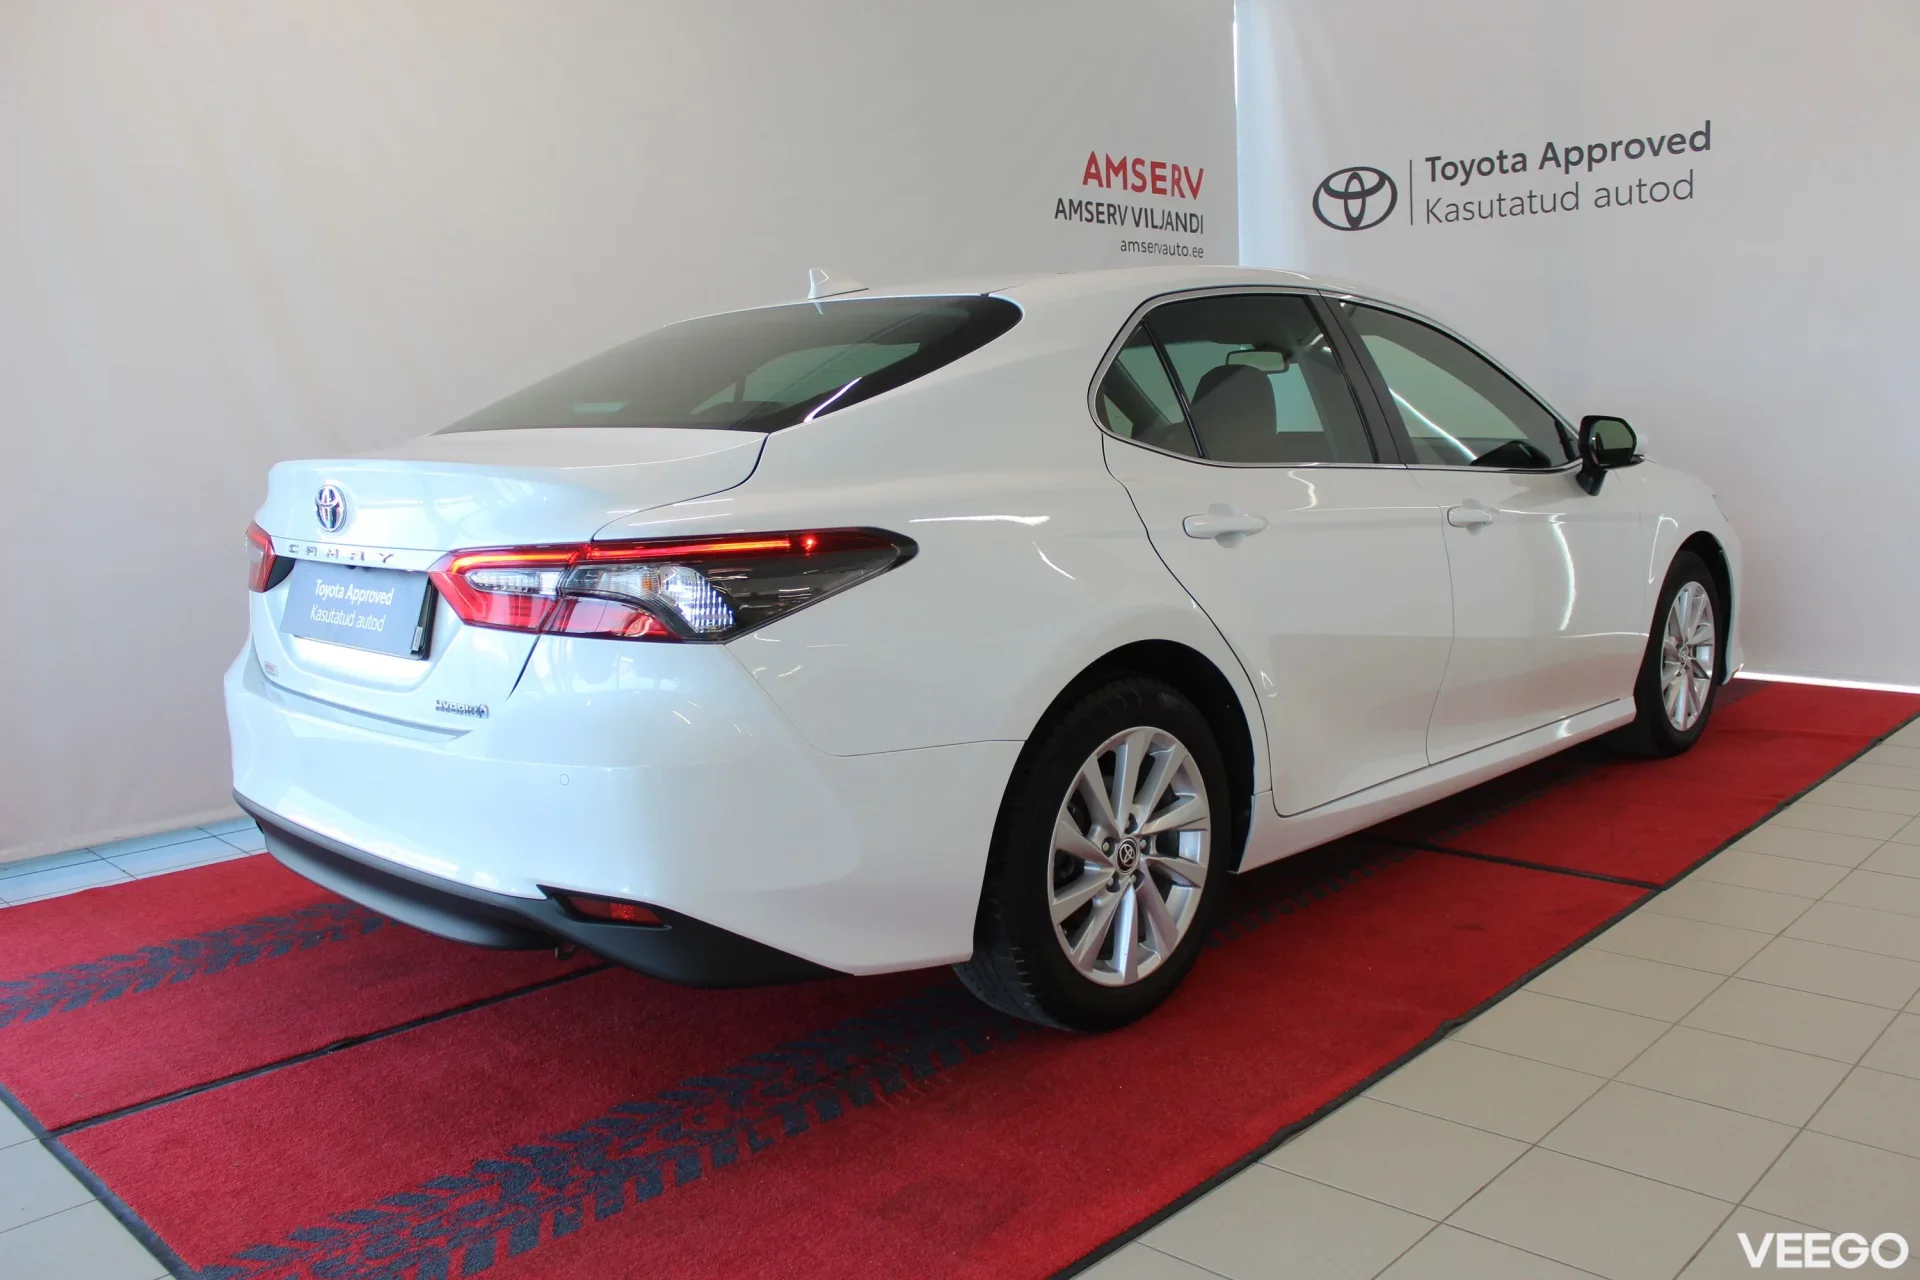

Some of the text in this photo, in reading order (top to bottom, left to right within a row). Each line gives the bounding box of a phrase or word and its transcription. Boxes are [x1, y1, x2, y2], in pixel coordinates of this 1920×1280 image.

[1425, 119, 1711, 186] Toyota Approved
[1082, 150, 1204, 200] AMSERV
[1426, 168, 1694, 224] Kasutatud autod
[1054, 197, 1204, 235] AMSERV VILJANDI
[1120, 239, 1204, 259] amservauto.ee
[315, 579, 395, 606] Toyota Approved
[310, 603, 386, 632] Kasutatud autod
